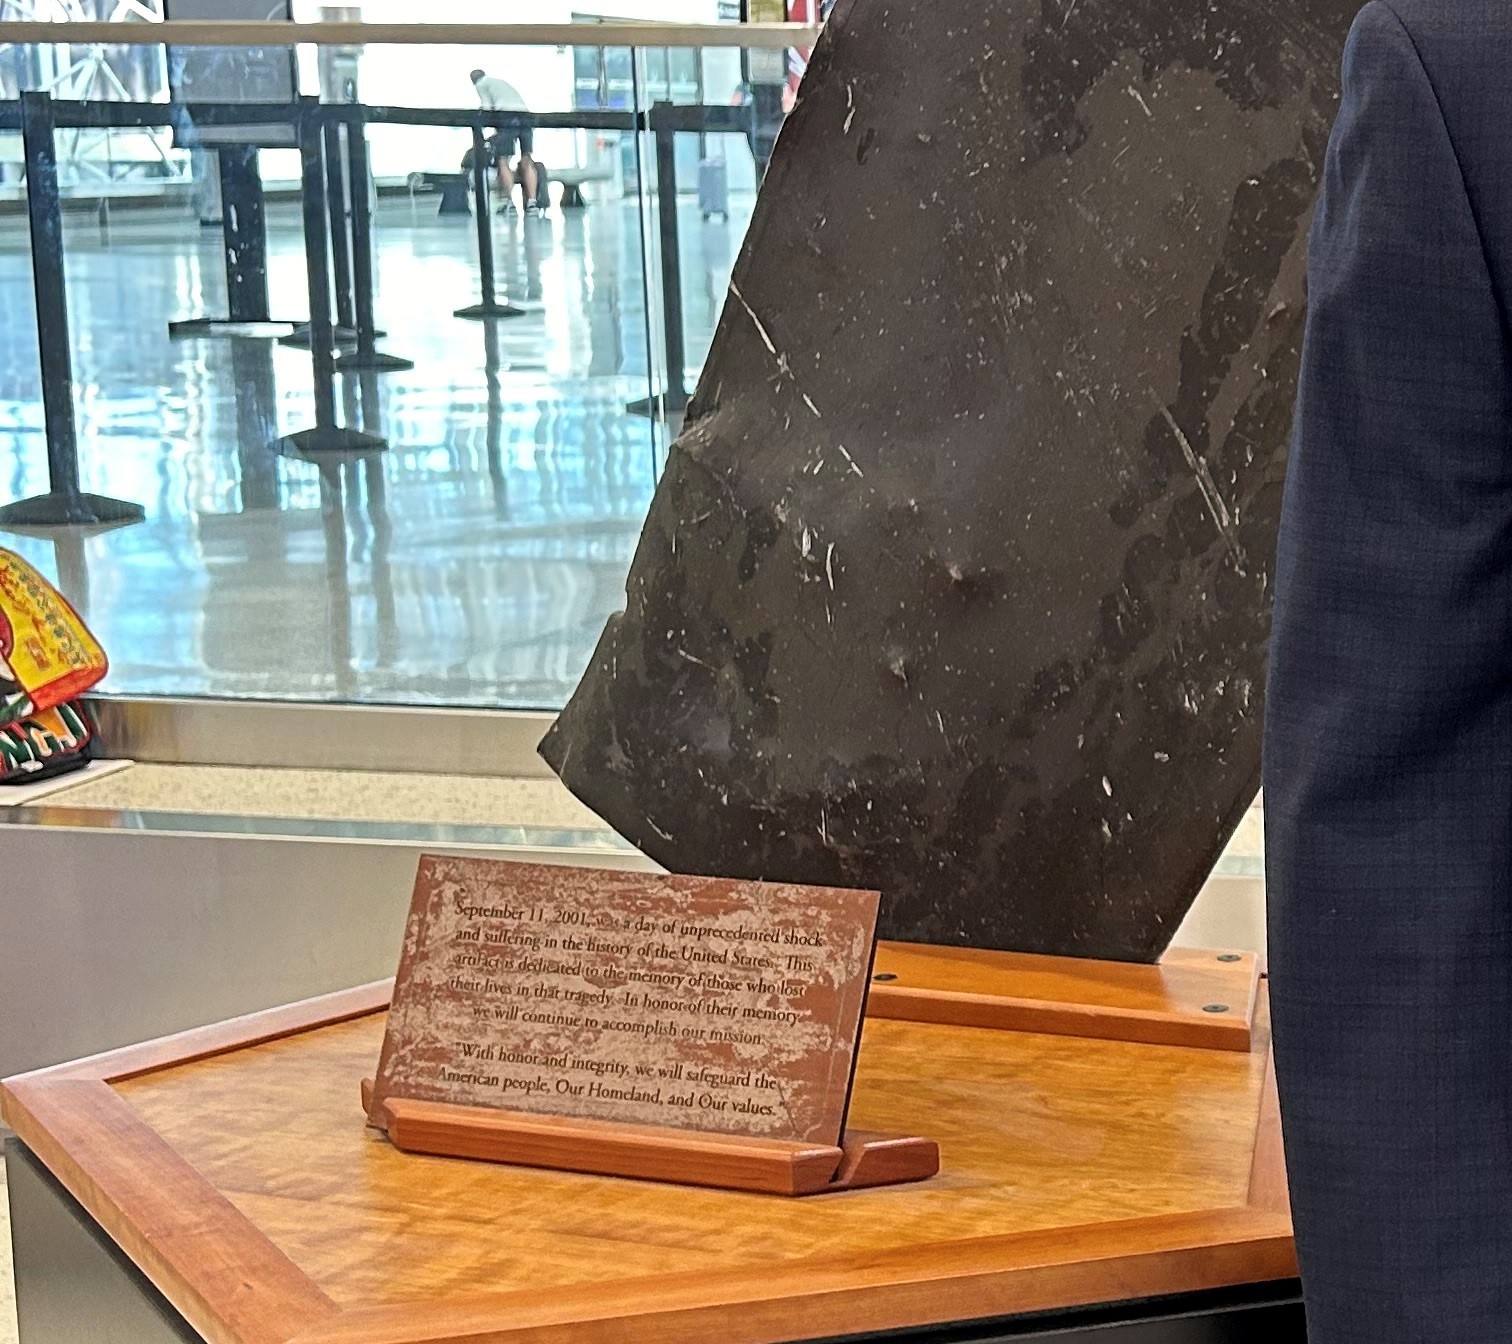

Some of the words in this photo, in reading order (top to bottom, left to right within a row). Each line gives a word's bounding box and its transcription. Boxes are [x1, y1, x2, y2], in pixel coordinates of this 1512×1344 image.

[454, 900, 525, 921] September
[529, 907, 549, 924] 11,
[623, 919, 631, 930] a
[634, 915, 656, 936] day
[662, 920, 678, 934] of
[680, 924, 781, 944] unprecedented
[783, 928, 823, 947] shock
[455, 927, 482, 941] and
[484, 929, 541, 952] suffering
[544, 933, 557, 949] in
[562, 934, 584, 951] the
[587, 936, 632, 959] history
[637, 942, 655, 956] of
[655, 943, 677, 960] the
[681, 945, 729, 965] United
[785, 955, 815, 971] This
[450, 974, 480, 992] their
[484, 977, 513, 995] lives
[516, 983, 530, 998] in
[534, 982, 560, 1000] that
[624, 992, 639, 1007] In
[643, 993, 684, 1011] honor
[687, 999, 703, 1015] of
[706, 998, 739, 1017] their
[453, 953, 501, 968] artifact
[504, 956, 514, 969] is
[518, 956, 582, 976] dedicated
[586, 964, 600, 977] to
[603, 963, 625, 979] the
[629, 970, 685, 990] memory
[688, 971, 704, 988] of
[707, 973, 743, 992] those
[747, 976, 776, 993] who
[780, 979, 806, 996] lost
[473, 1005, 491, 1019] we
[494, 1005, 519, 1021] will
[521, 1009, 582, 1028] continue
[585, 1016, 599, 1029] to
[601, 1018, 678, 1039] accomplish
[682, 1025, 706, 1038] our
[437, 1065, 500, 1087] American
[555, 1077, 585, 1097] Our
[587, 1081, 665, 1106] Homeland,
[667, 1091, 695, 1109] and
[698, 1092, 728, 1111] Our
[498, 1045, 541, 1066] honor
[542, 1053, 569, 1069] and
[571, 1055, 631, 1079] integrity,
[635, 1063, 655, 1078] we
[657, 1063, 684, 1081] will
[685, 1067, 751, 1089] safeguard
[754, 1072, 778, 1091] the
